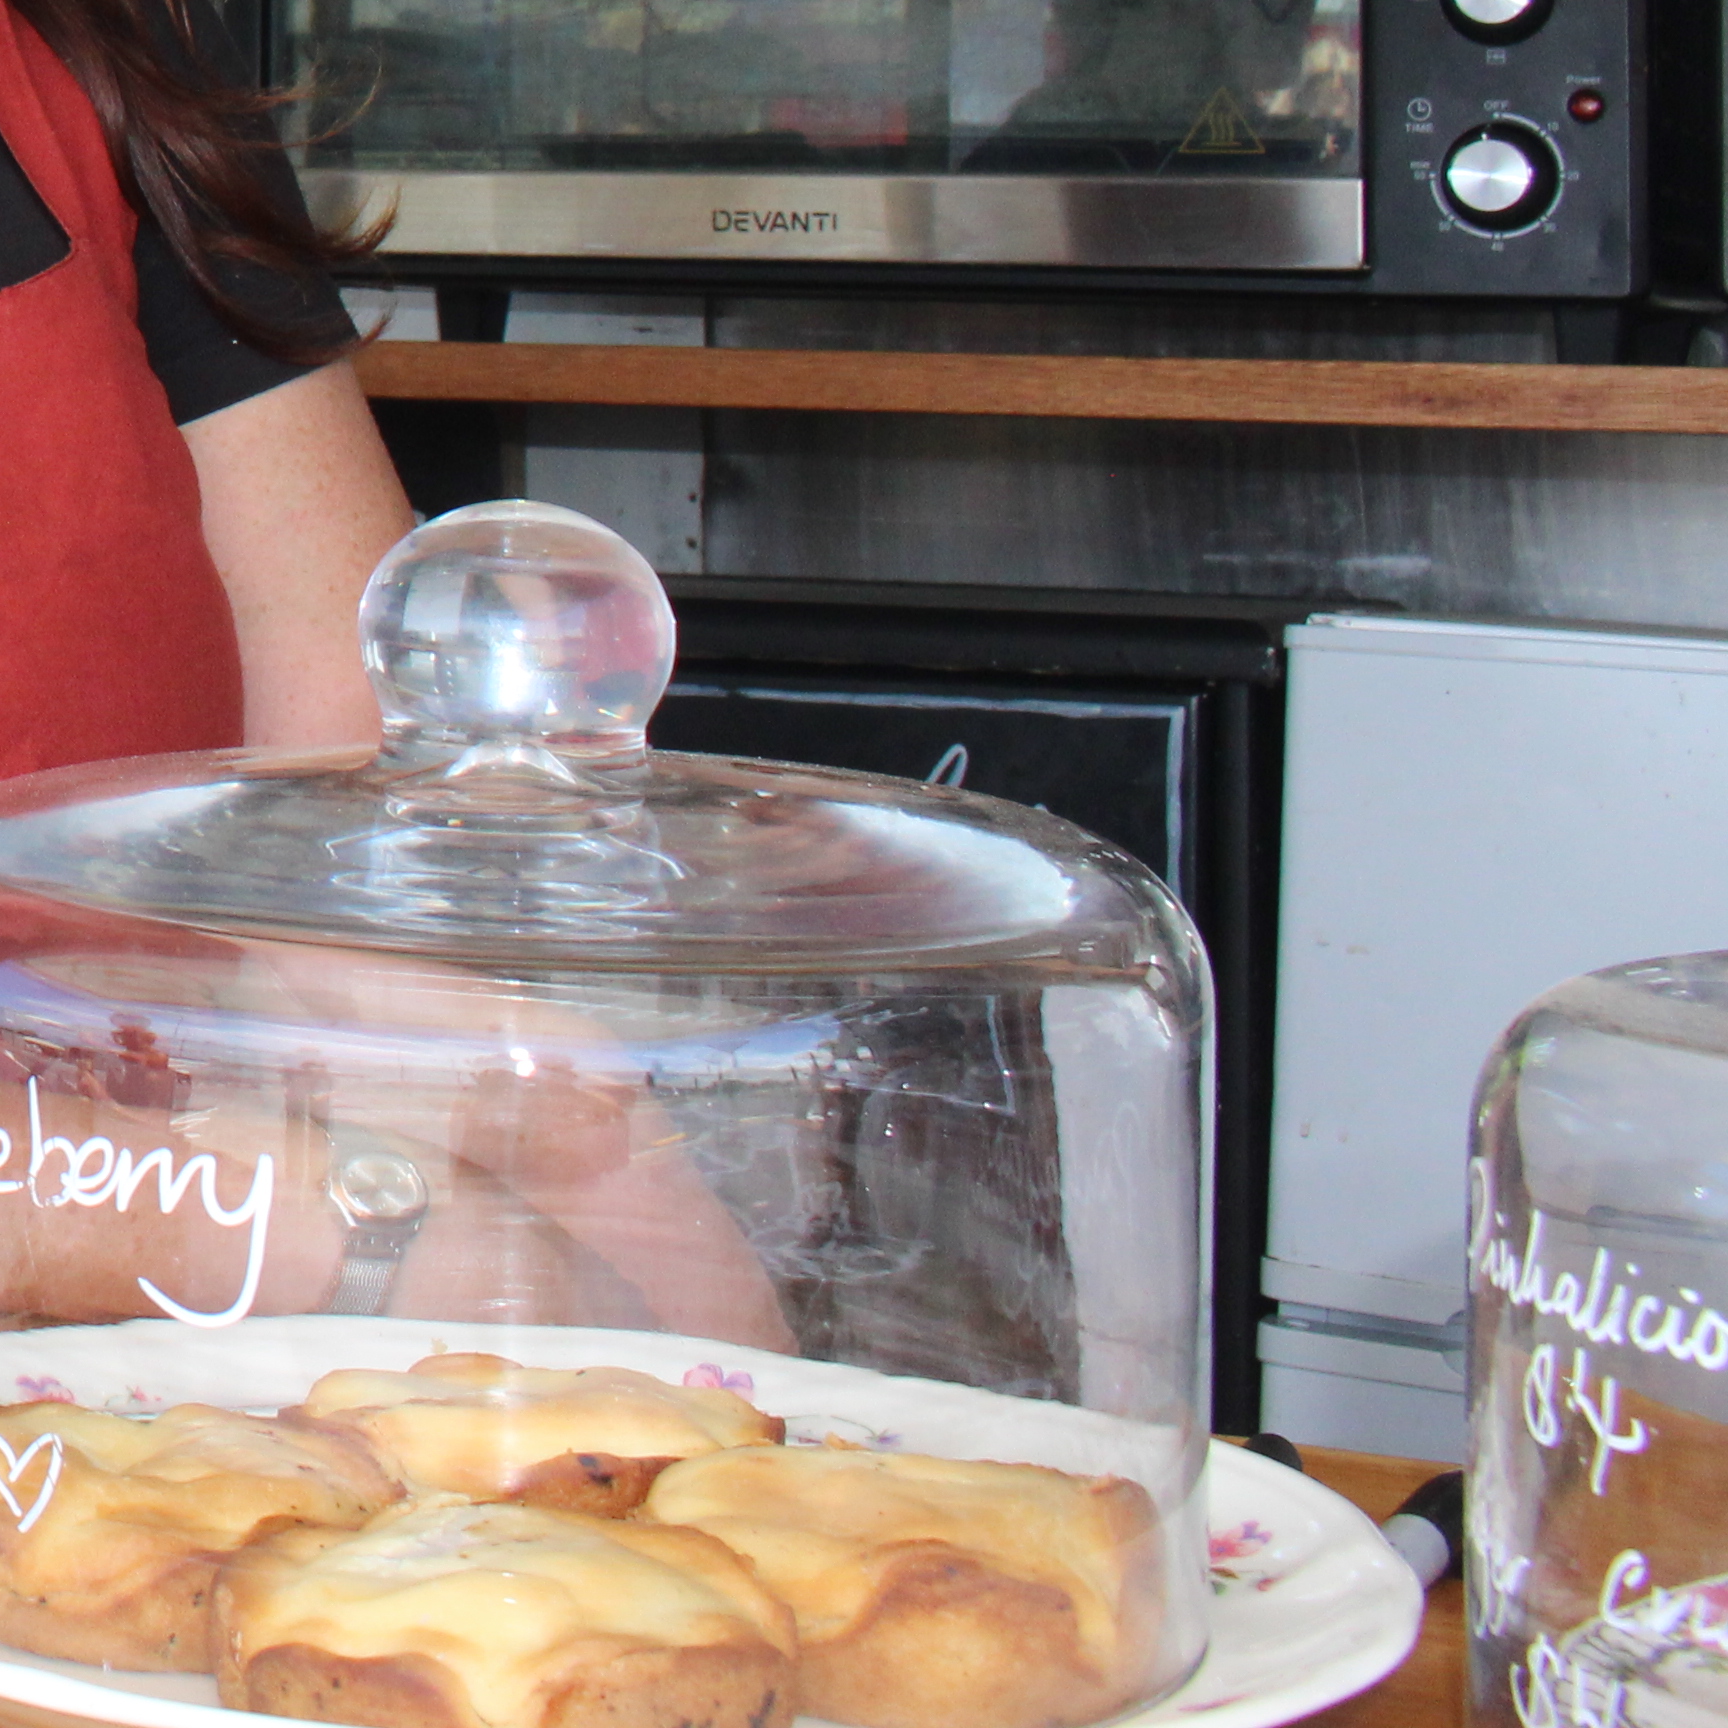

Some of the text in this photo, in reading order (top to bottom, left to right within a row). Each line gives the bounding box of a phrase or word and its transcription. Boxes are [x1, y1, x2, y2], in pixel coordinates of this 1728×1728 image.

[1566, 75, 1601, 85] Power
[1405, 123, 1433, 134] TIME
[712, 209, 837, 232] DEVANTI
